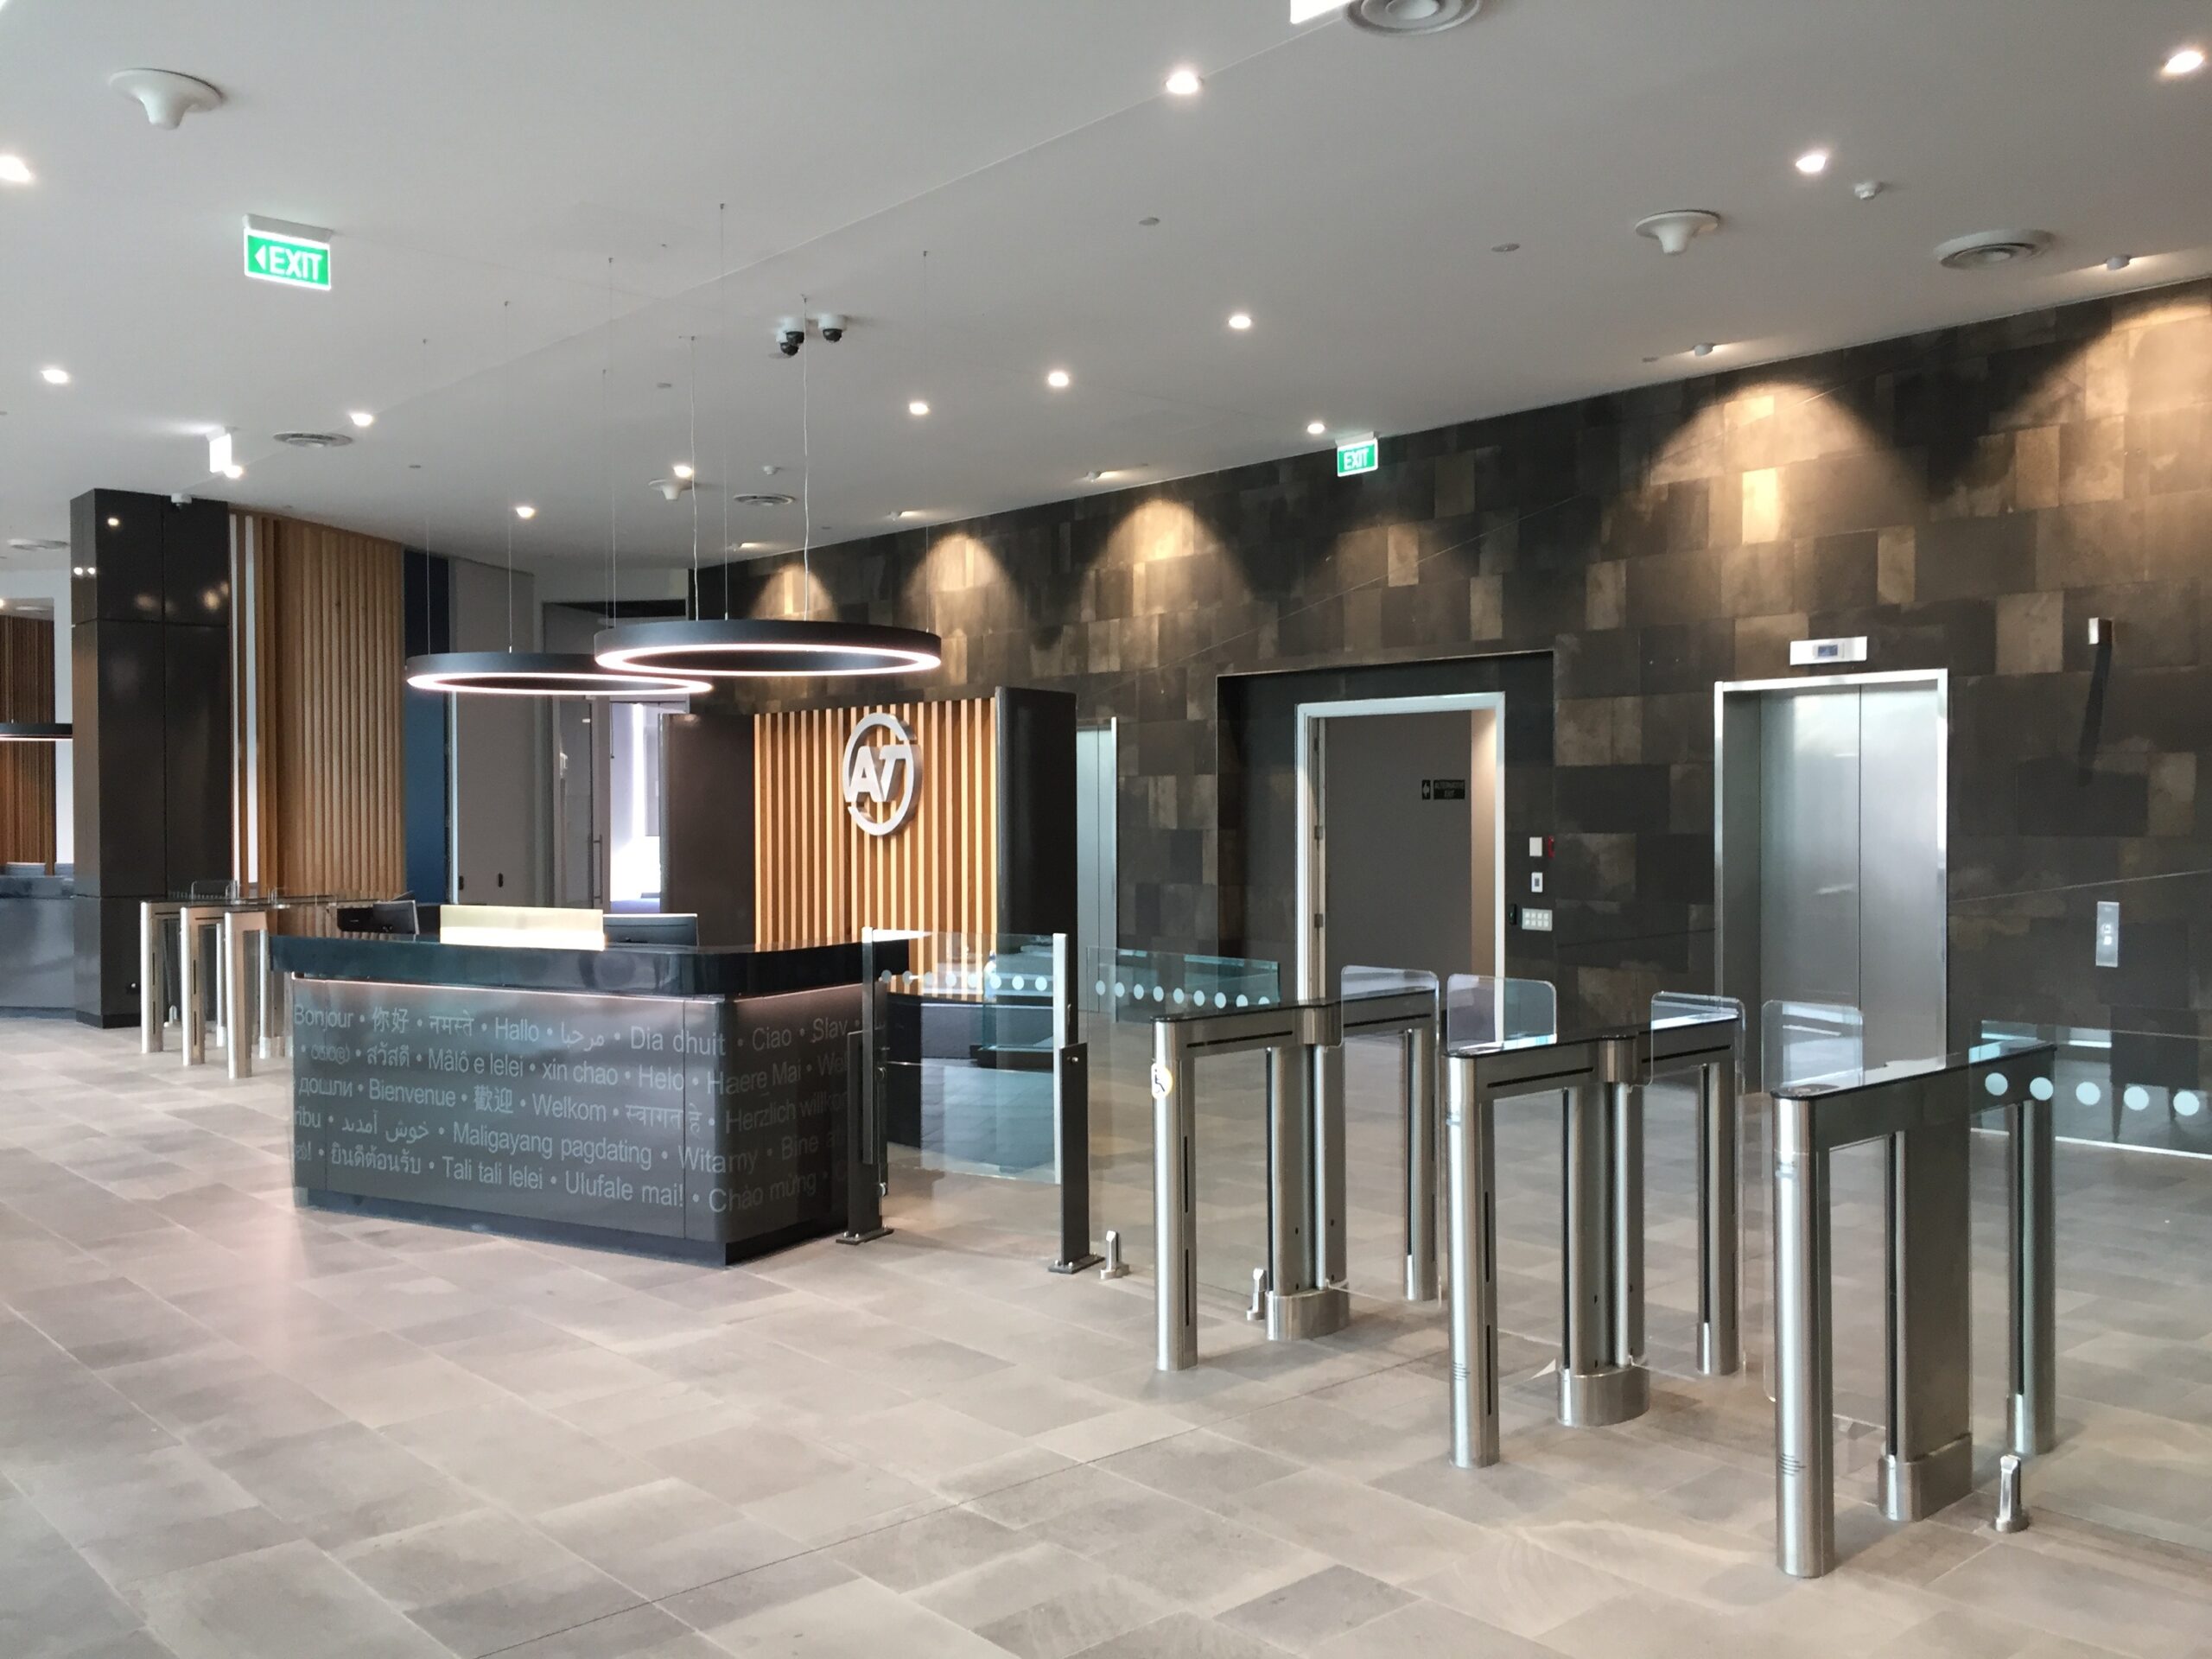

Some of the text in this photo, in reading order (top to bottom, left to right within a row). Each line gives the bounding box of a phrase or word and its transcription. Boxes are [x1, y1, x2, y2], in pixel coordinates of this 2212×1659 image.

[269, 245, 322, 281] EXIT
[1344, 448, 1369, 471] EXIT
[295, 1004, 353, 1032] Bonjour
[372, 1007, 410, 1033] 你好
[429, 1009, 474, 1037] नमस्ते
[495, 1017, 539, 1042] Hallo
[562, 1021, 604, 1052] مرحبا
[630, 1026, 664, 1051] Dia
[673, 1028, 725, 1056] dhuit
[753, 1027, 792, 1051] Ciao
[367, 1040, 410, 1067] สวัสดี
[429, 1048, 469, 1073] Mâlô
[474, 1057, 485, 1074] e
[490, 1052, 524, 1077] lelei
[543, 1058, 568, 1081] xin
[573, 1060, 618, 1085] chao
[639, 1065, 684, 1090] Helo
[707, 1069, 768, 1096] Haere
[772, 1058, 802, 1086] Mai
[298, 1077, 353, 1097] дошли
[369, 1078, 456, 1108] Bienvenue
[474, 1084, 513, 1114] 歡迎
[532, 1093, 607, 1122] Welkom
[626, 1104, 684, 1129] स्वागत
[725, 1099, 797, 1135] Herzlich
[385, 1121, 429, 1144] خوش
[453, 1122, 553, 1160] Maligayang
[561, 1137, 652, 1171] pagdating
[780, 1134, 819, 1160] Bine
[331, 1141, 422, 1174] ยินดีต้อนรับ
[442, 1155, 472, 1180] Tali
[478, 1161, 502, 1185] tali
[509, 1164, 543, 1189] lelei
[565, 1170, 633, 1201] Ulufale
[642, 1182, 683, 1207] mai!
